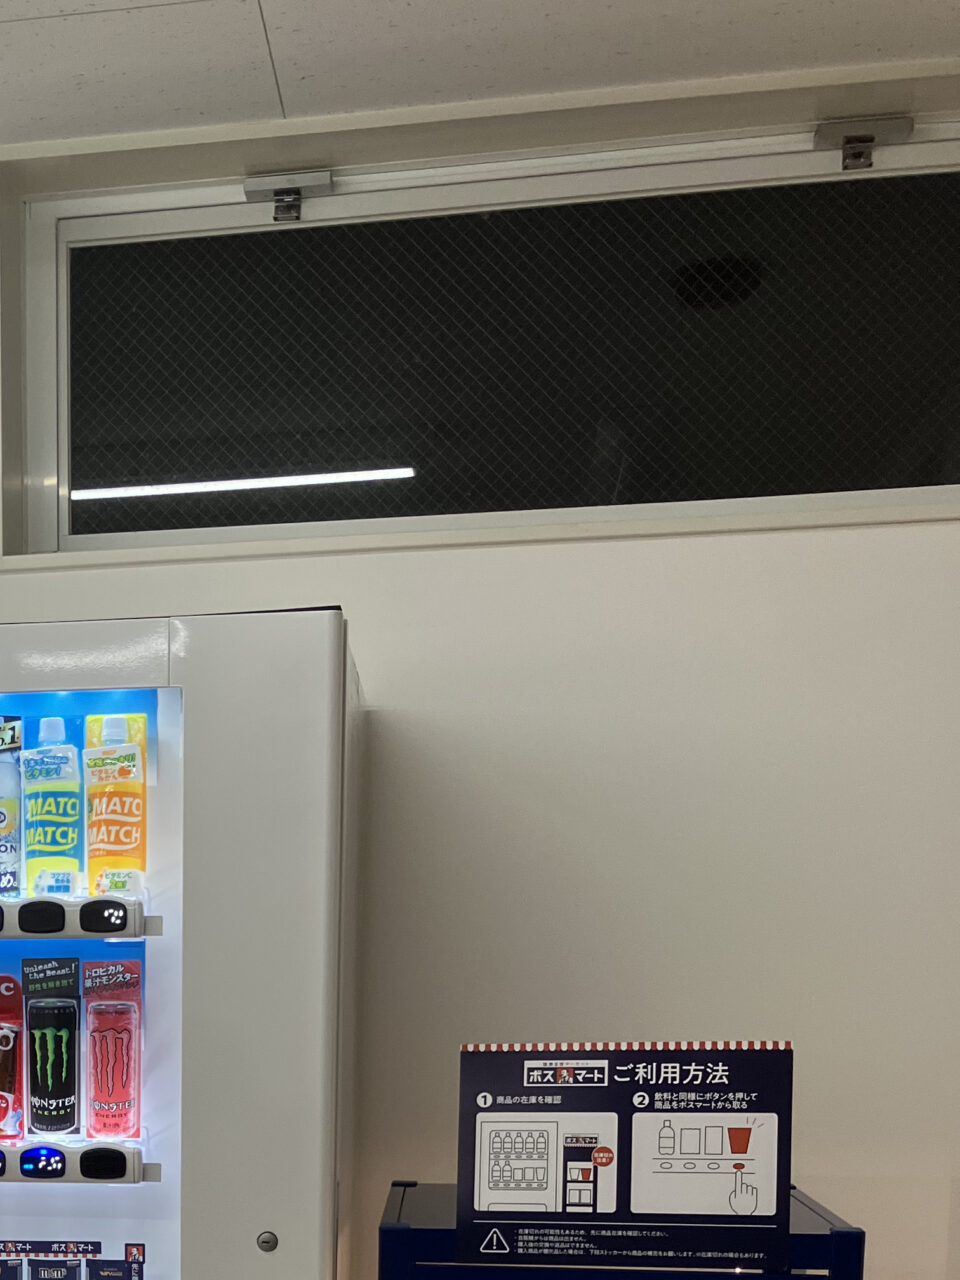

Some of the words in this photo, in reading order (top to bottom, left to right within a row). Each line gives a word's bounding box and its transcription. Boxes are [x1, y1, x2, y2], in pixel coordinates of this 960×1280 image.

[29, 798, 79, 816] MATC
[93, 798, 142, 815] MATC
[26, 827, 78, 844] MATCH
[89, 827, 140, 844] MATCH
[86, 965, 125, 978] トロピカル
[613, 1062, 730, 1085] ご利用方法
[496, 1095, 562, 1104] 商品の在庫を確認
[654, 1092, 758, 1101] 飲料と同様にボタンを押して
[654, 1100, 748, 1110] 商品をボスマートから取る
